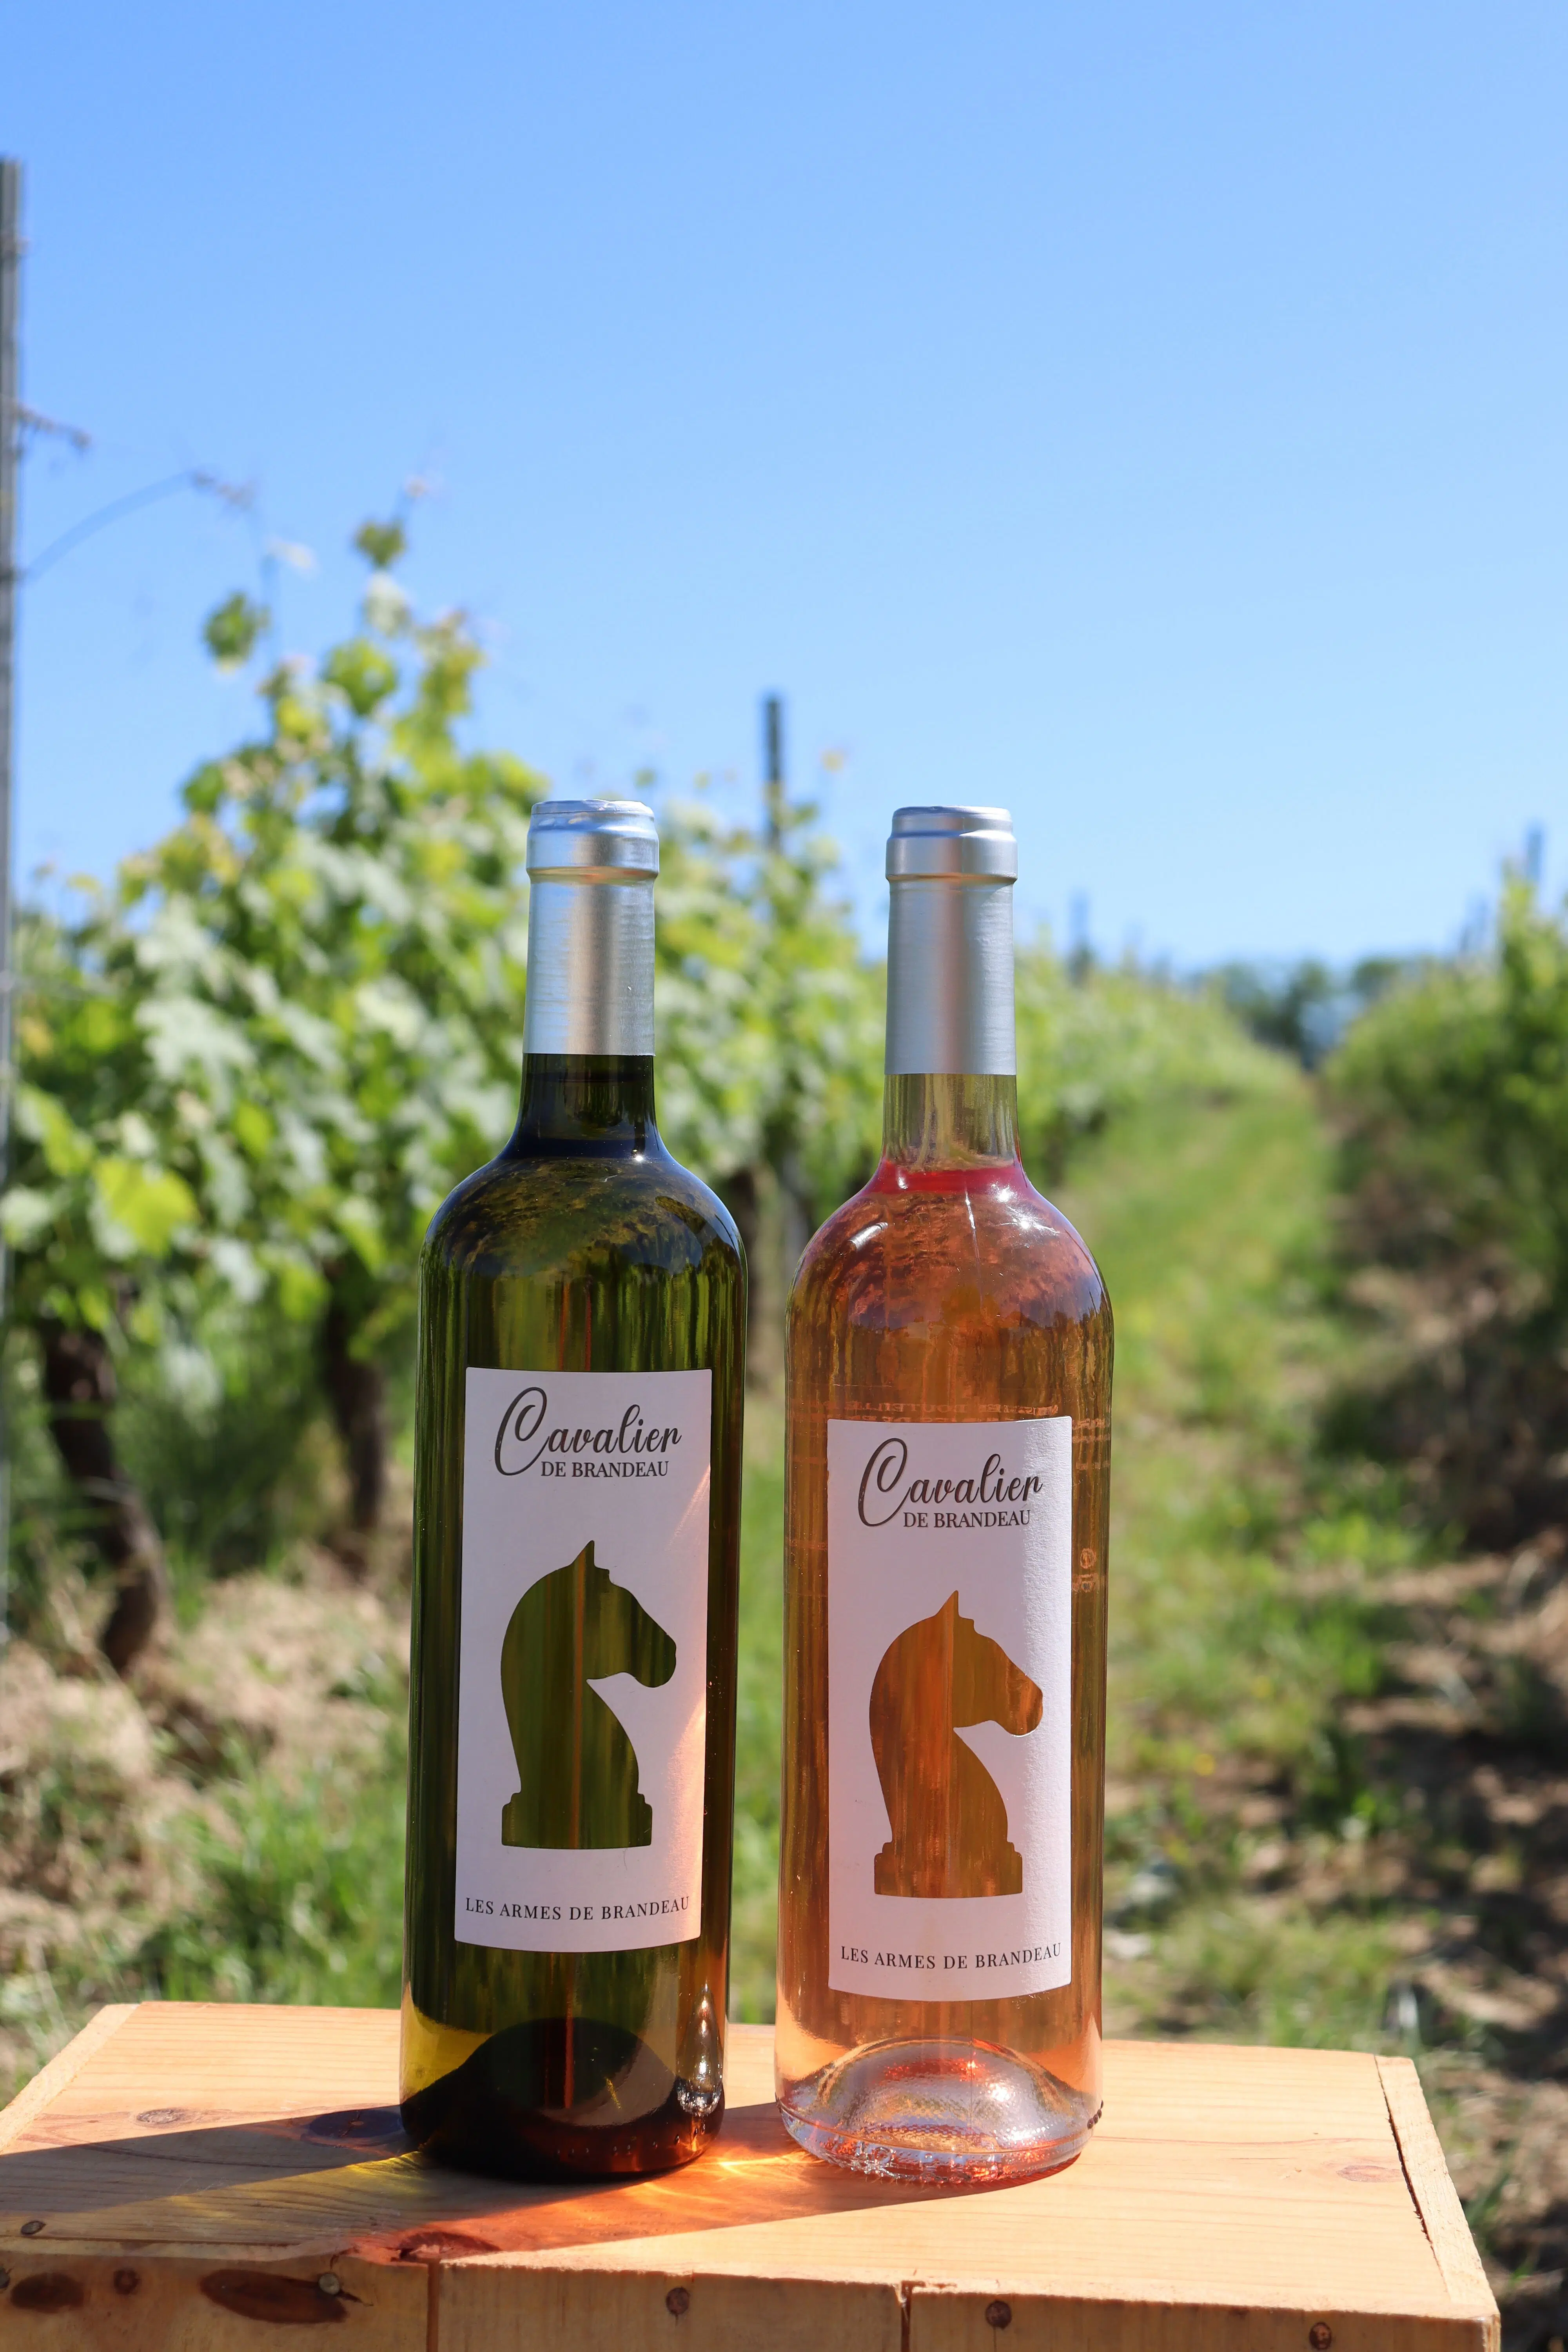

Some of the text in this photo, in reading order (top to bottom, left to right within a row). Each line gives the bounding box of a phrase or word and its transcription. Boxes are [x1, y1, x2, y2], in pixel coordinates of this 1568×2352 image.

[495, 1387, 682, 1476] Cavalier
[541, 1461, 669, 1477] DE BRANDEAU
[858, 1437, 1043, 1527] Cavalier
[904, 1510, 1031, 1528] DE BRANDEAU
[466, 1896, 689, 1920] LES ARMES DE BRANDEAU
[841, 1942, 1061, 1969] LES ARMES DE BRANDEAU
